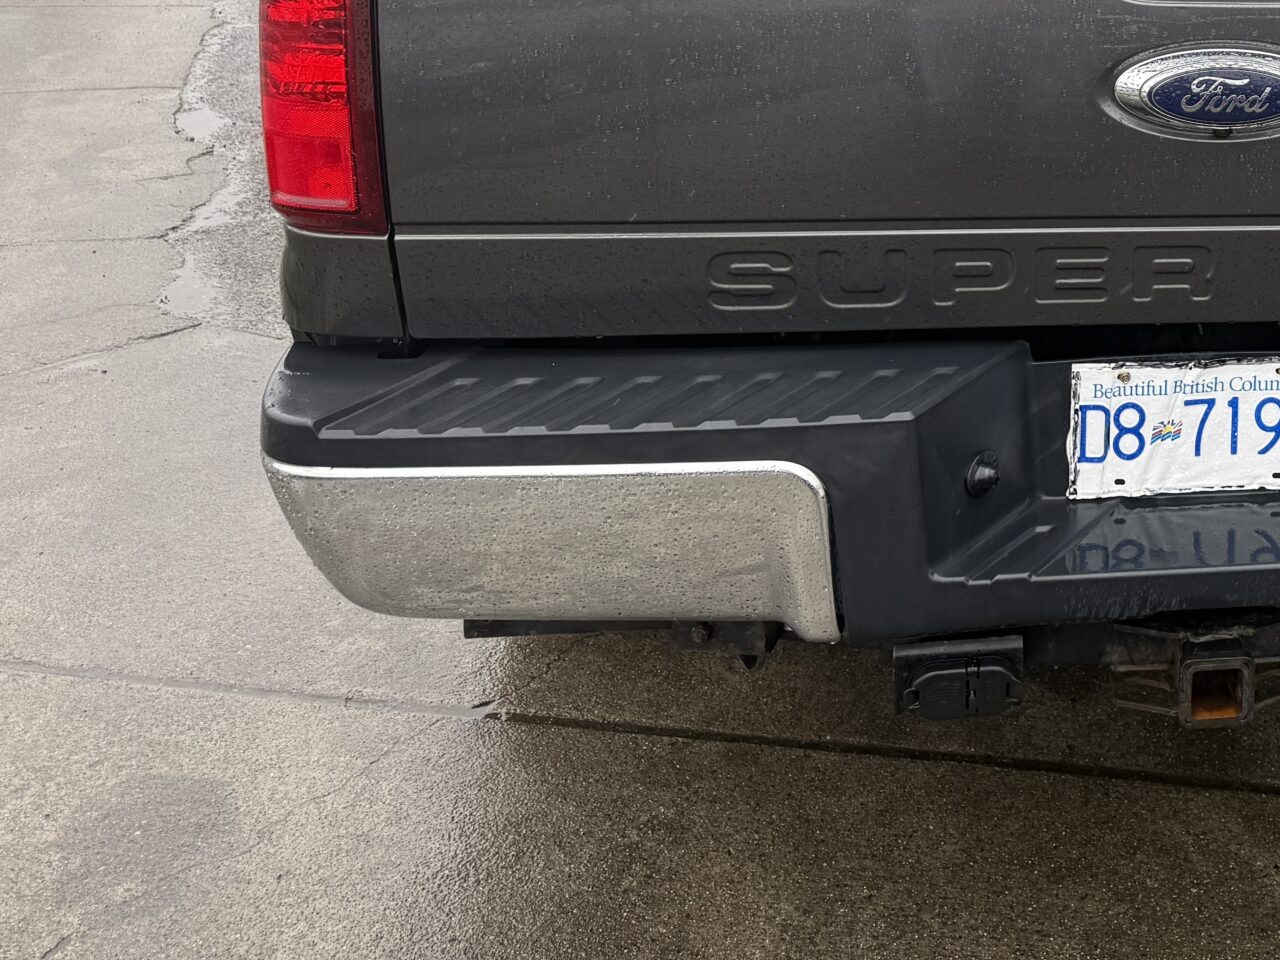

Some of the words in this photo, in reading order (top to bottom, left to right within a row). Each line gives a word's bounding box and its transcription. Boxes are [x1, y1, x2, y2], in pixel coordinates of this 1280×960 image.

[1181, 76, 1272, 113] Ford
[707, 245, 1213, 310] SUPER
[1093, 378, 1169, 398] Beautiful
[1172, 376, 1225, 394] British
[1077, 402, 1147, 464] D8
